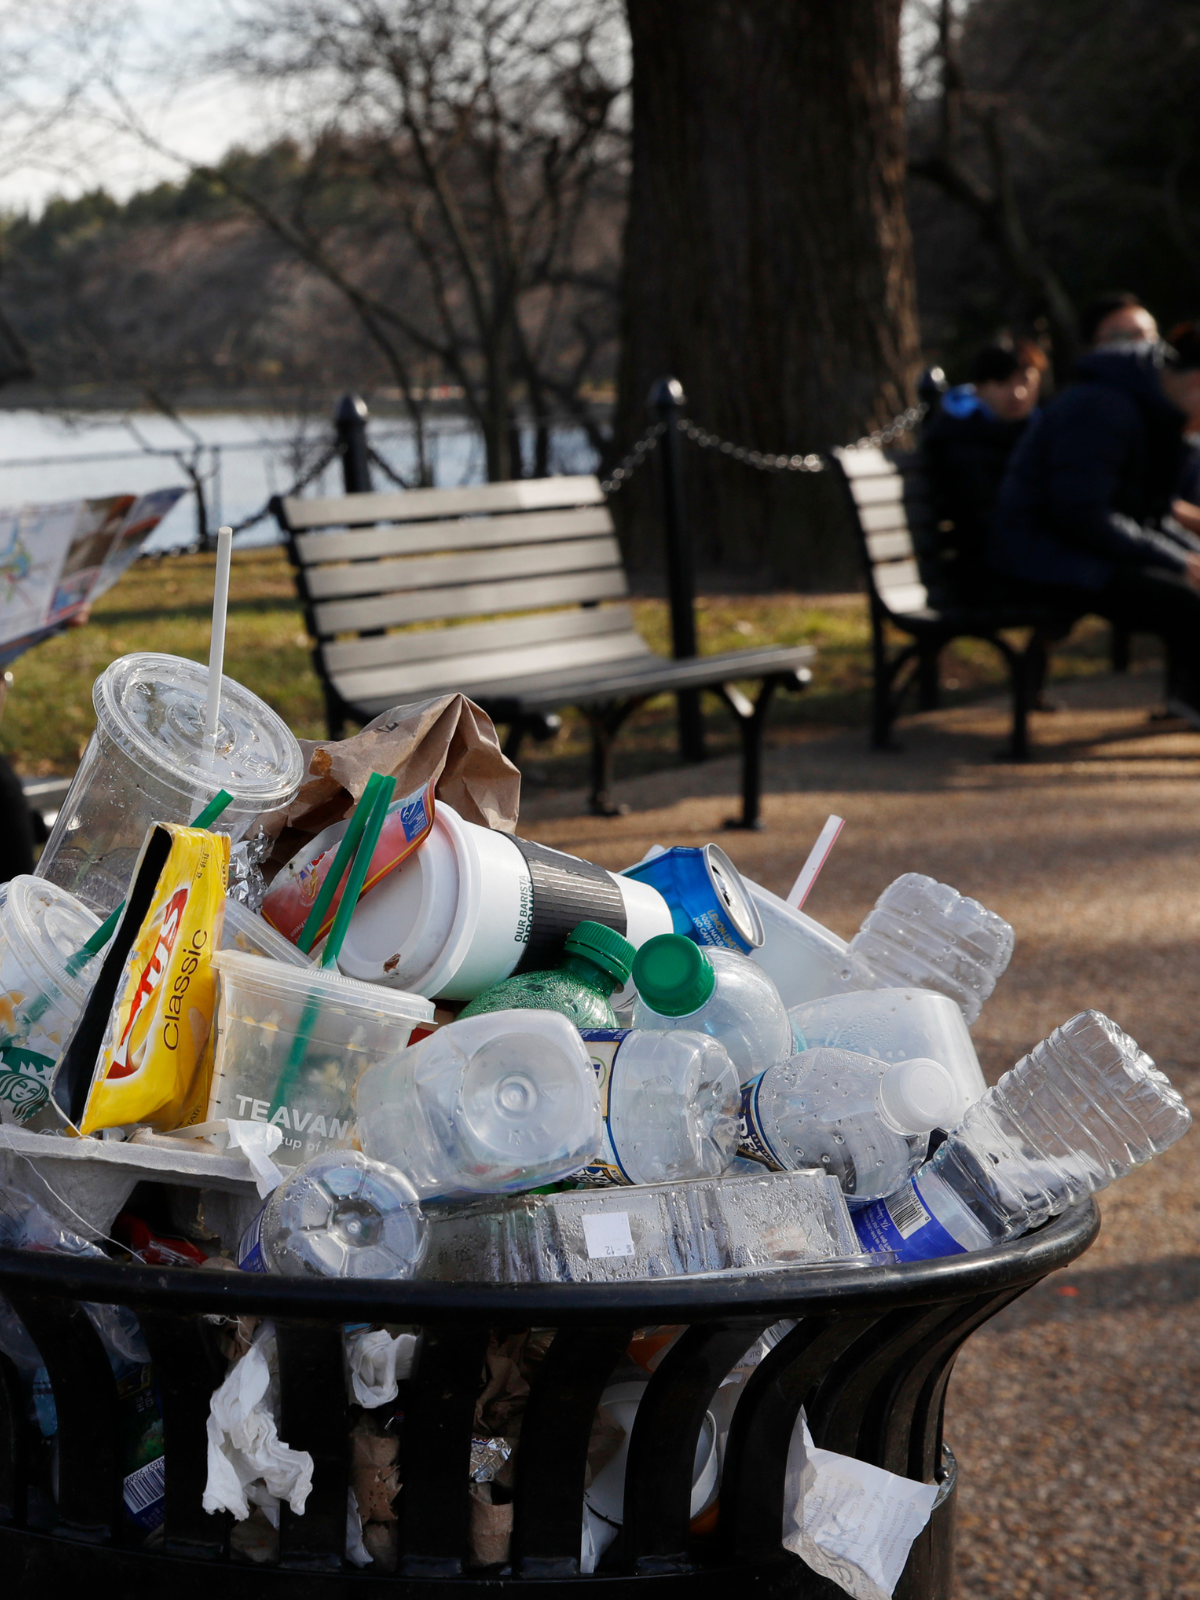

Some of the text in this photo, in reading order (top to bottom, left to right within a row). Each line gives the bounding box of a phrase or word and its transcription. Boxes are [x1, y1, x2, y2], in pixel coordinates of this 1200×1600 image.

[514, 875, 528, 942] OUR BARISTA
[693, 917, 702, 928] NO
[701, 913, 712, 930] 100%
[163, 929, 208, 1051] Classic
